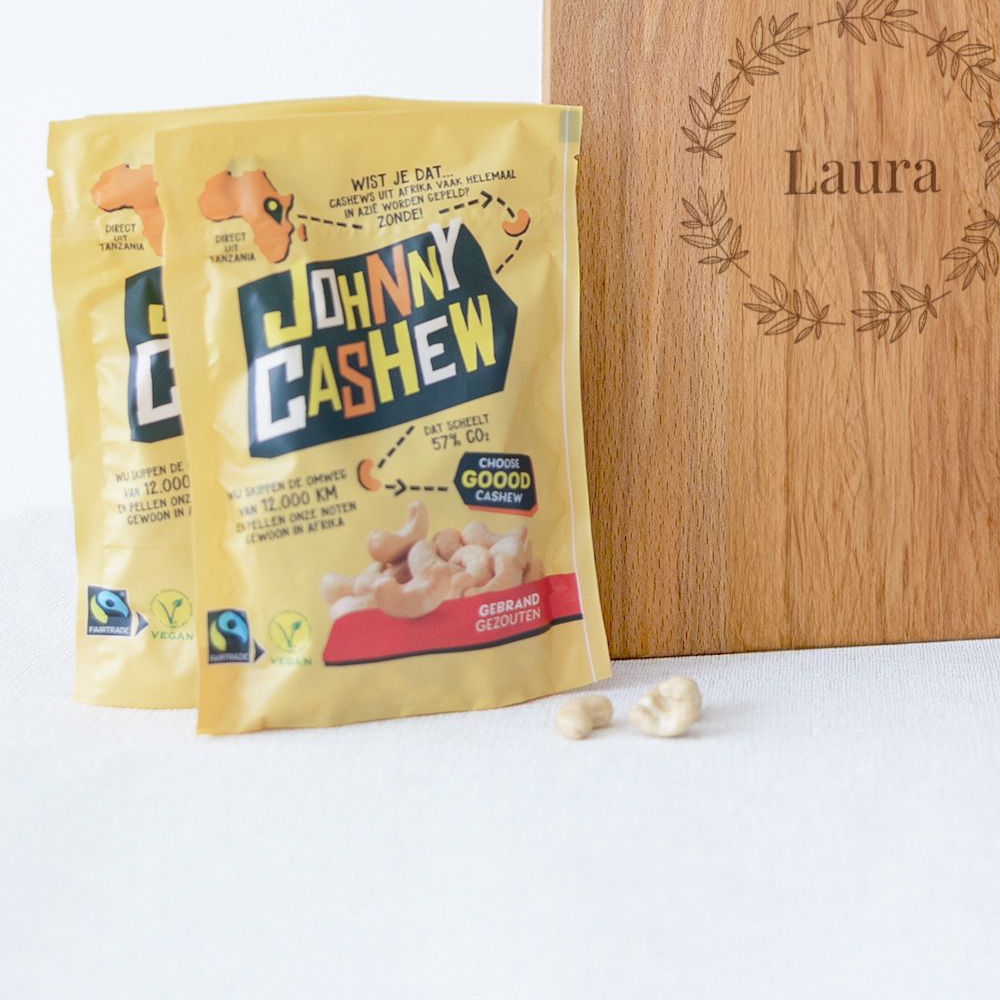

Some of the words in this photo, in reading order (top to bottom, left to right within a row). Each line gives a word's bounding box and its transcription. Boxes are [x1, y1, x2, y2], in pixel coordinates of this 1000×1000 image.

[351, 173, 387, 192] WIST
[393, 170, 409, 186] JE
[415, 165, 454, 181] DAT...
[784, 149, 941, 196] Laura
[329, 191, 376, 209] CASHEWS
[378, 189, 394, 201] UIT
[399, 184, 433, 198] AFRIKA
[436, 177, 463, 190] VAAK
[466, 169, 517, 185] HELEMAAL
[344, 208, 355, 219] IN
[381, 195, 425, 213] WORDEN
[427, 187, 470, 203] GEPELD?
[377, 208, 424, 229] ZONDE!
[105, 223, 137, 234] DIRECT
[113, 234, 128, 242] UIT
[215, 232, 247, 243] DIRECT
[99, 242, 145, 251] TANZANIA
[208, 252, 256, 263] TANZANIA
[263, 217, 462, 349] JOHNNY
[254, 294, 497, 443] CASHEW
[424, 423, 443, 436] DAT
[447, 413, 490, 431] SCHEELT
[432, 435, 462, 451] 57%
[170, 461, 184, 474] DE
[478, 457, 521, 470] CHOOSE
[144, 474, 191, 495] 12.000
[288, 477, 302, 489] DE
[306, 468, 347, 486] OMWEG
[460, 469, 531, 490] GOOOD
[316, 484, 338, 502] KM
[475, 489, 524, 504] CASHEW
[130, 498, 167, 513] PELLEN
[171, 493, 192, 507] ONZ
[321, 501, 357, 517] NOTEN
[127, 509, 171, 526] GEWOON
[173, 507, 185, 518] IN
[293, 524, 304, 535] IN
[307, 516, 345, 533] AFRIKA
[478, 593, 541, 617] GEBRAND
[475, 607, 541, 633] GEZOUTEN
[88, 625, 131, 635] FAIRTRADE
[151, 630, 194, 641] VEGAN
